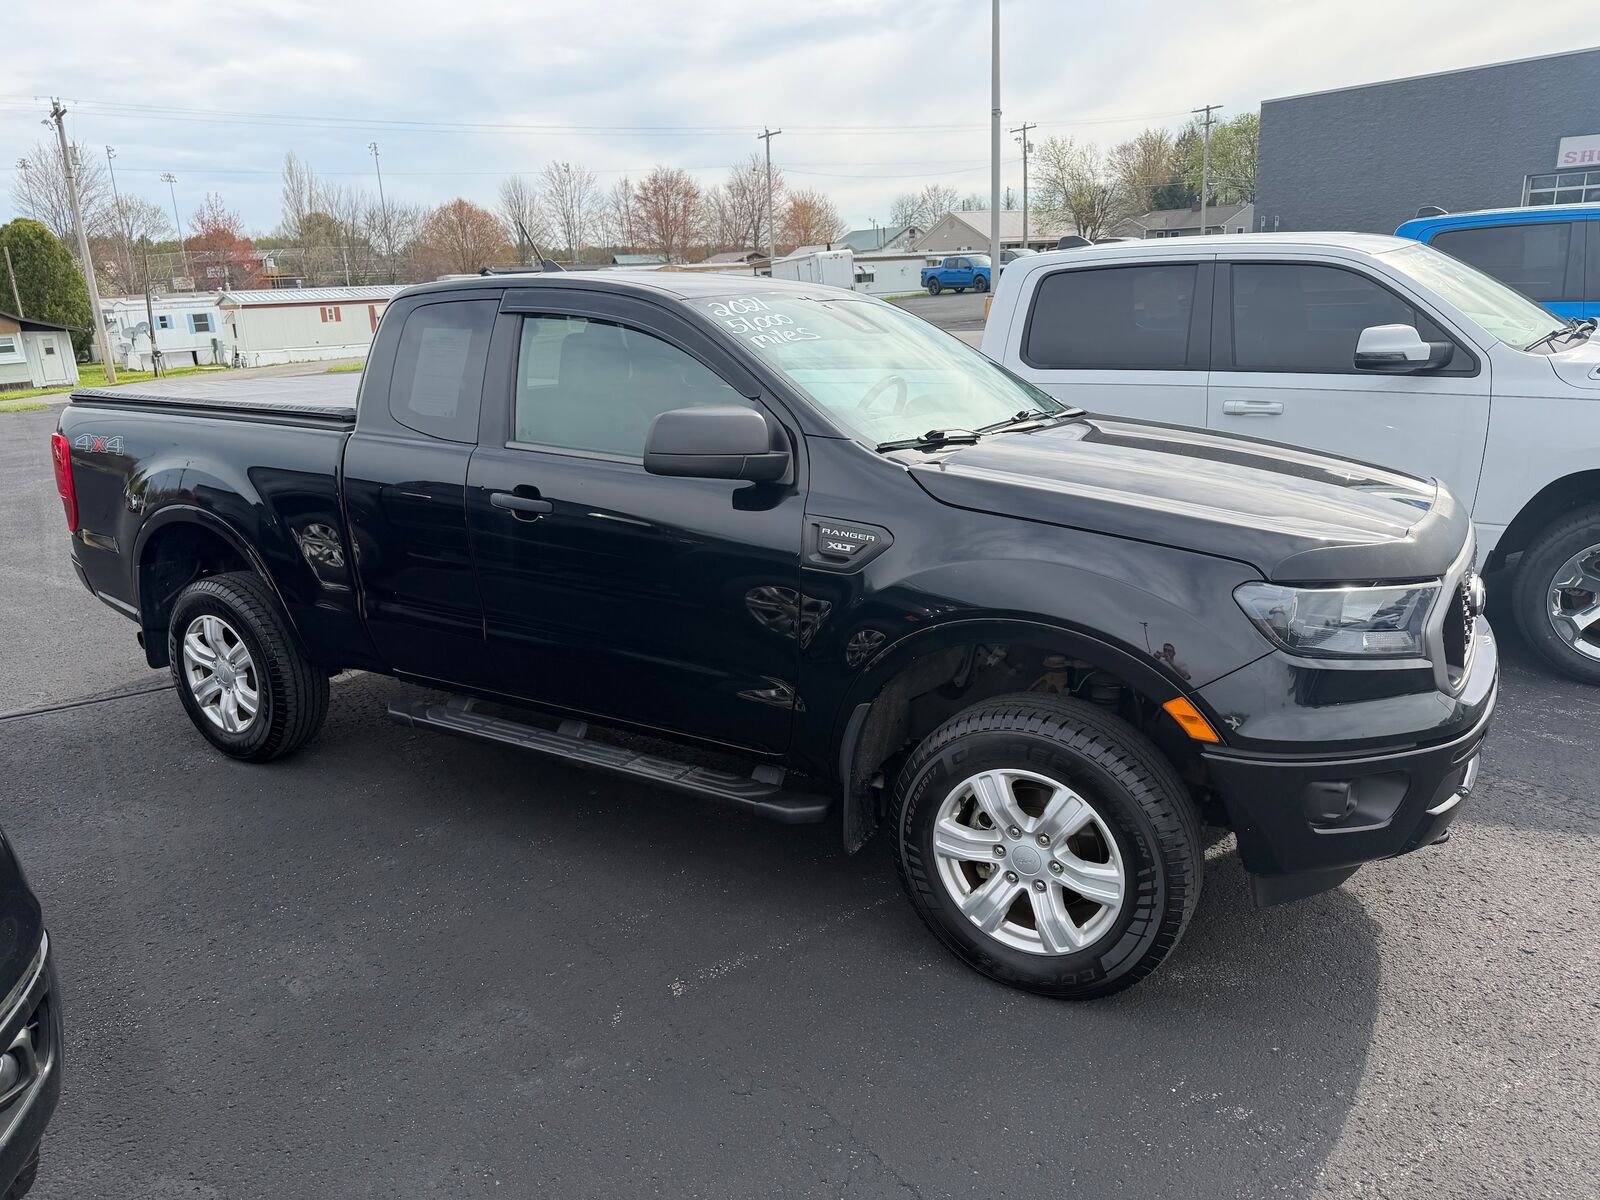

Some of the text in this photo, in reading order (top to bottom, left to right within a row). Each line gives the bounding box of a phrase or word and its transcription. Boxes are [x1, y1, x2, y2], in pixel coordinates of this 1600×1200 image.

[1564, 149, 1600, 163] SH
[707, 296, 771, 316] 2021
[725, 313, 794, 333] 51,000
[750, 327, 821, 348] miles
[821, 527, 875, 541] RANGER
[827, 541, 855, 551] XLT
